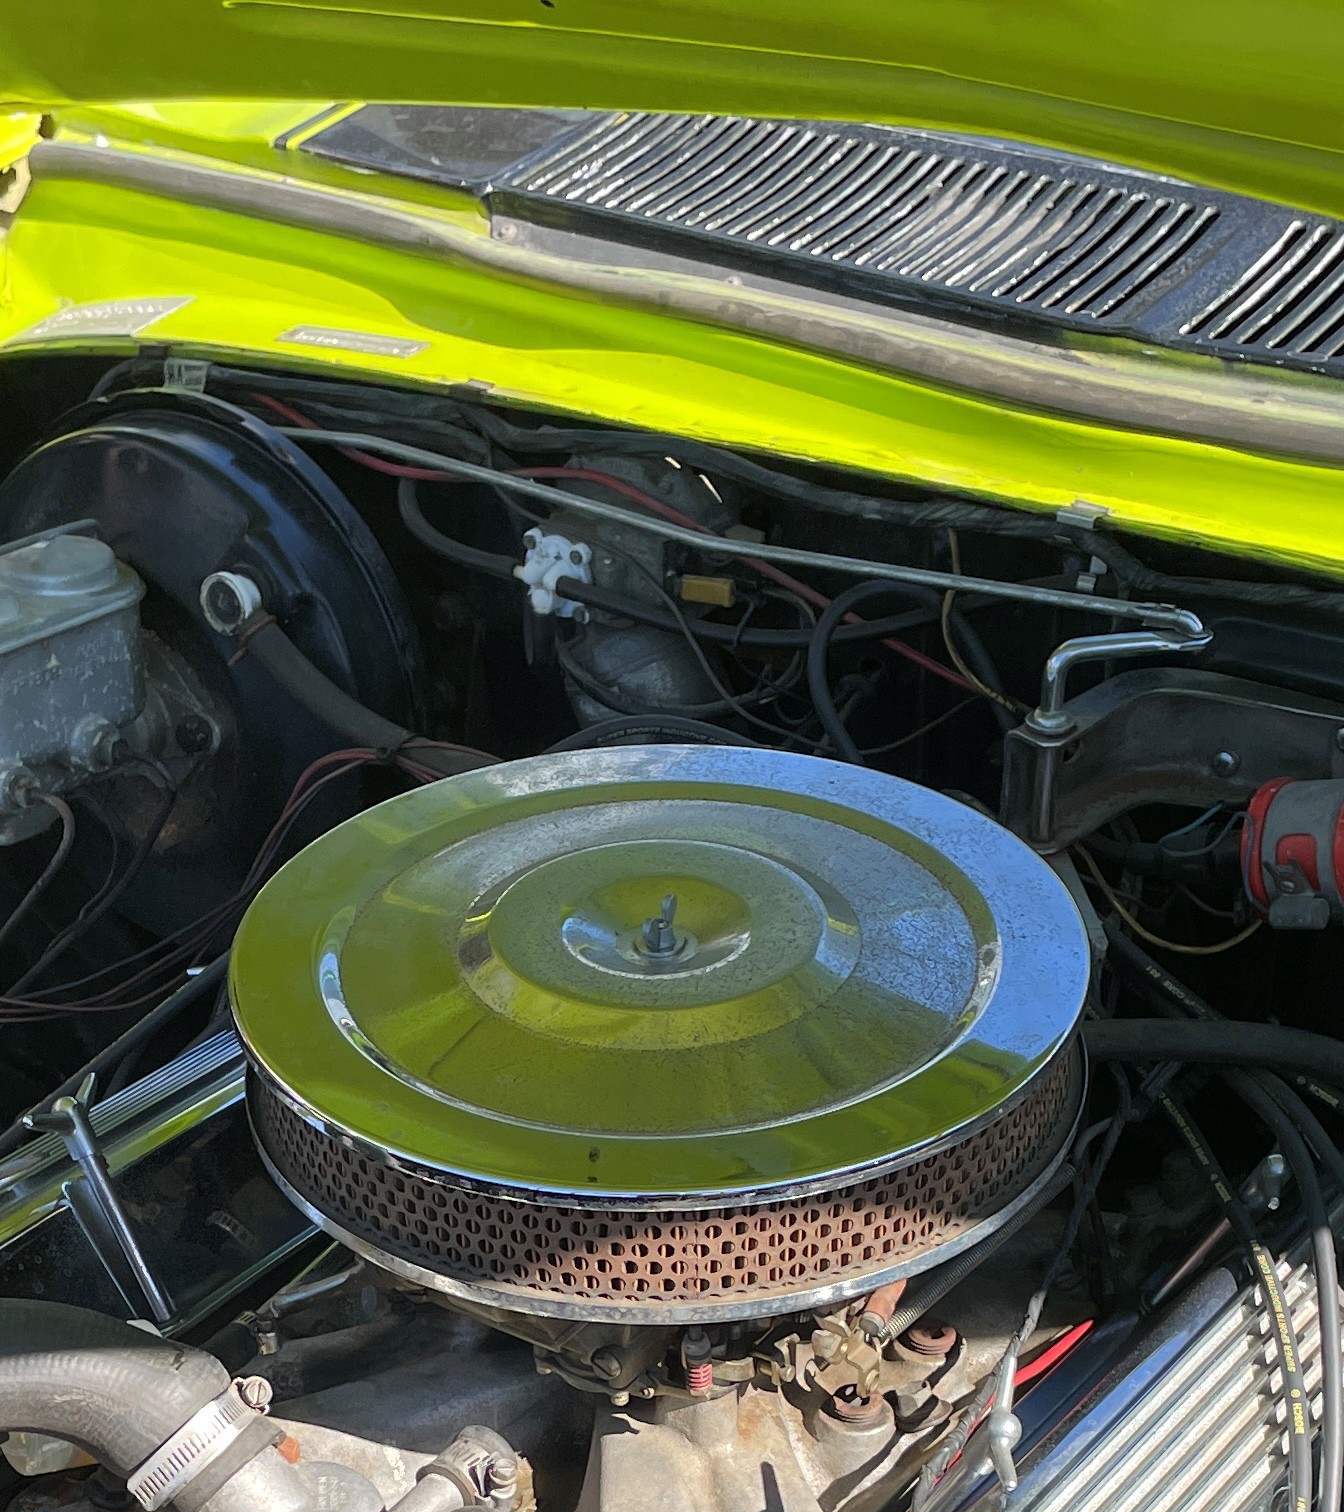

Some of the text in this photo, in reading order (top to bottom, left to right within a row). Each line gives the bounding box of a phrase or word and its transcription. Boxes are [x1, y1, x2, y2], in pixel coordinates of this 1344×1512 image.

[1257, 1254, 1271, 1274] CORE
[1264, 1275, 1283, 1313] INDUCTIVE
[1276, 1312, 1291, 1344] SPORTS
[1283, 1345, 1296, 1373] SUPER
[1292, 1402, 1305, 1435] BOSCH
